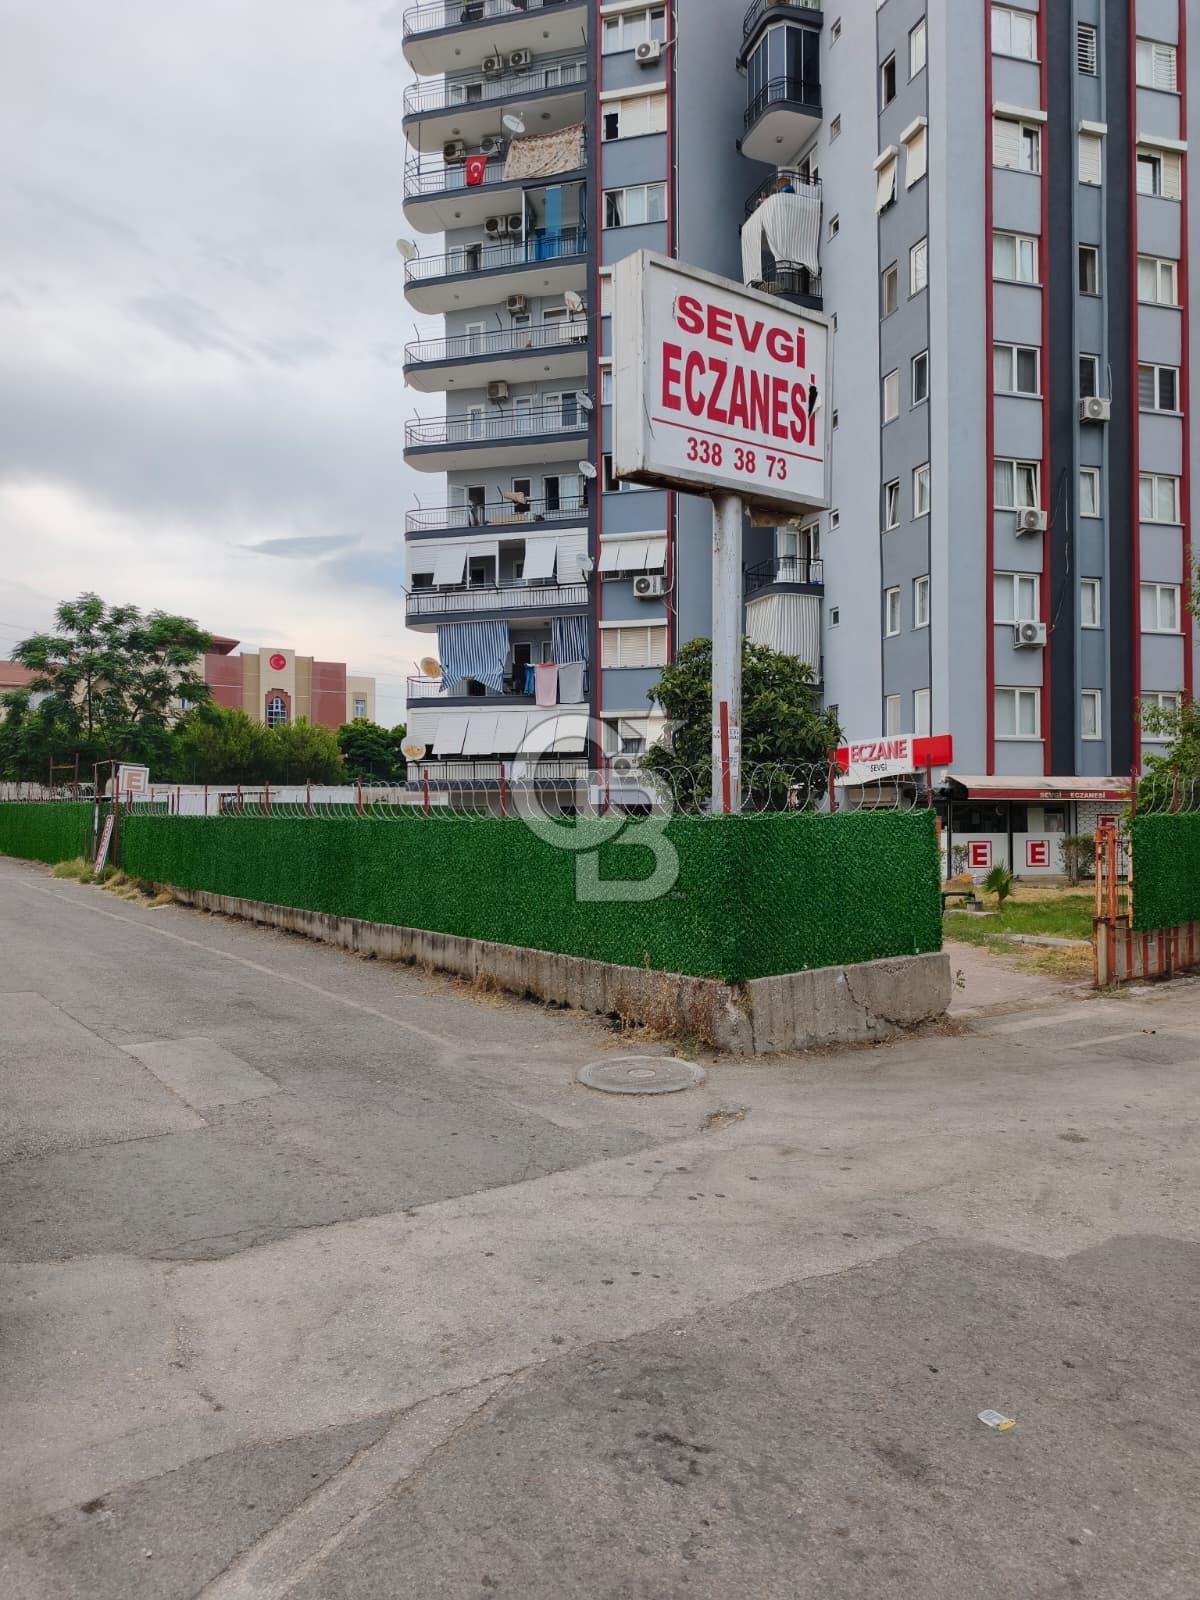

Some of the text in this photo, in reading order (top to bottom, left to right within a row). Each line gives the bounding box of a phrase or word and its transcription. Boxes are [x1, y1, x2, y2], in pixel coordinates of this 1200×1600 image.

[677, 295, 806, 369] SEVGİ
[662, 341, 816, 447] ECZANESİ
[687, 437, 787, 480] 338 38 73
[851, 739, 908, 763] ECZANE
[973, 845, 987, 865] E
[1031, 844, 1045, 863] E
